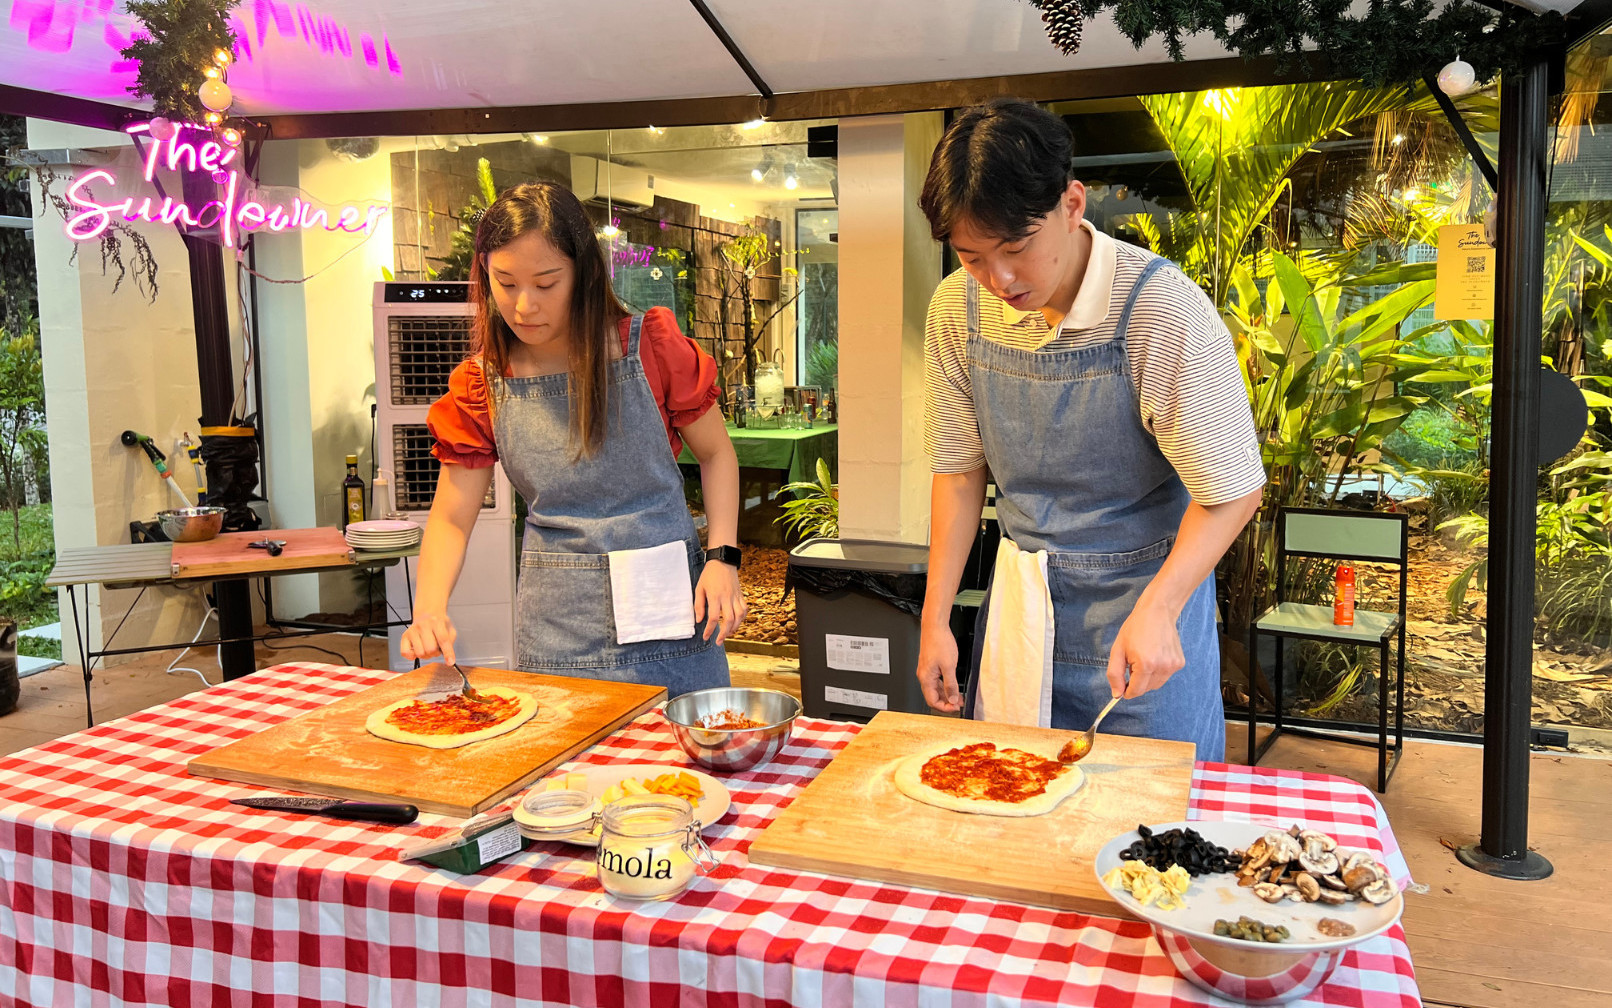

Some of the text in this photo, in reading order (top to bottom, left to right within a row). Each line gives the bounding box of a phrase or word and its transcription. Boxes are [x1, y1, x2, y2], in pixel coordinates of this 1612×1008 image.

[126, 122, 236, 182] The
[65, 170, 387, 248] Sundowner
[1466, 231, 1480, 240] The
[410, 289, 425, 298] 25
[599, 848, 673, 880] mola
